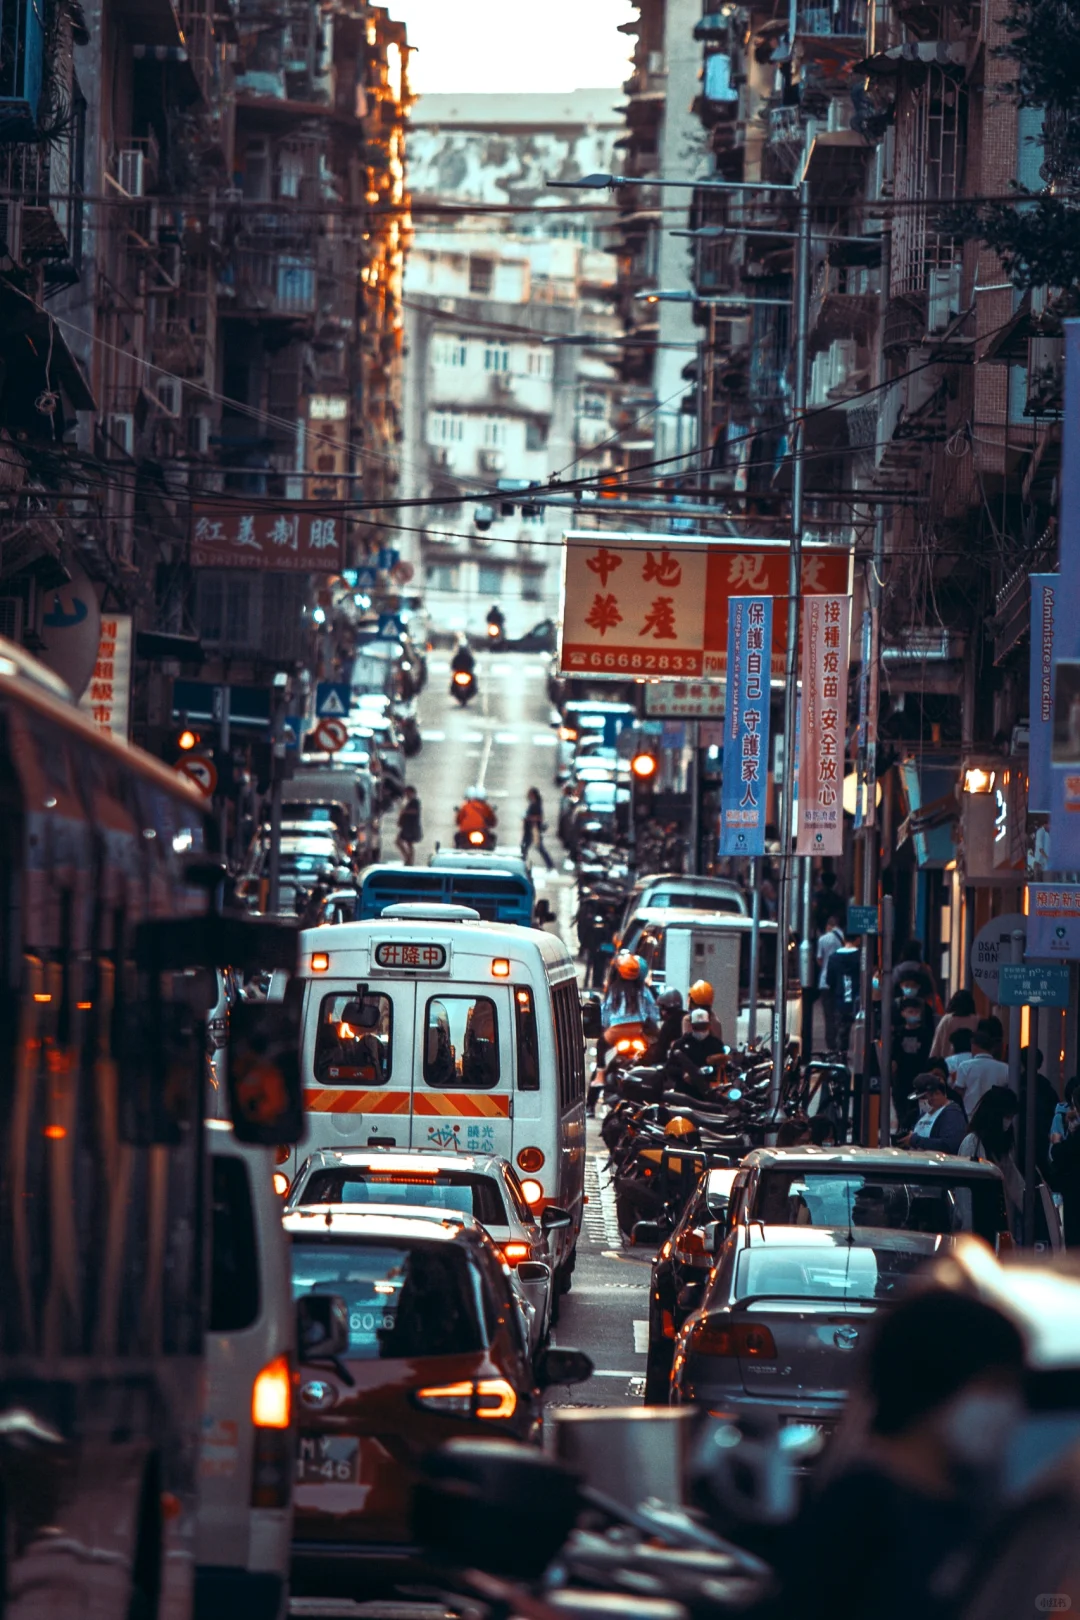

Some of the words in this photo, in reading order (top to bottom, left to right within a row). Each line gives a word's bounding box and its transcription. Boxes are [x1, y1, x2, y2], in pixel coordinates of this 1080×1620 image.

[747, 602, 765, 700] 保護自己
[822, 600, 841, 700] 接種疫苗
[1043, 587, 1055, 661] Administre
[590, 652, 697, 671] 66682833
[1043, 664, 1051, 673] a
[1042, 677, 1053, 721] vacina
[740, 709, 762, 807] 守護家人
[818, 708, 838, 807] 安全放心
[381, 945, 439, 966] 升降中
